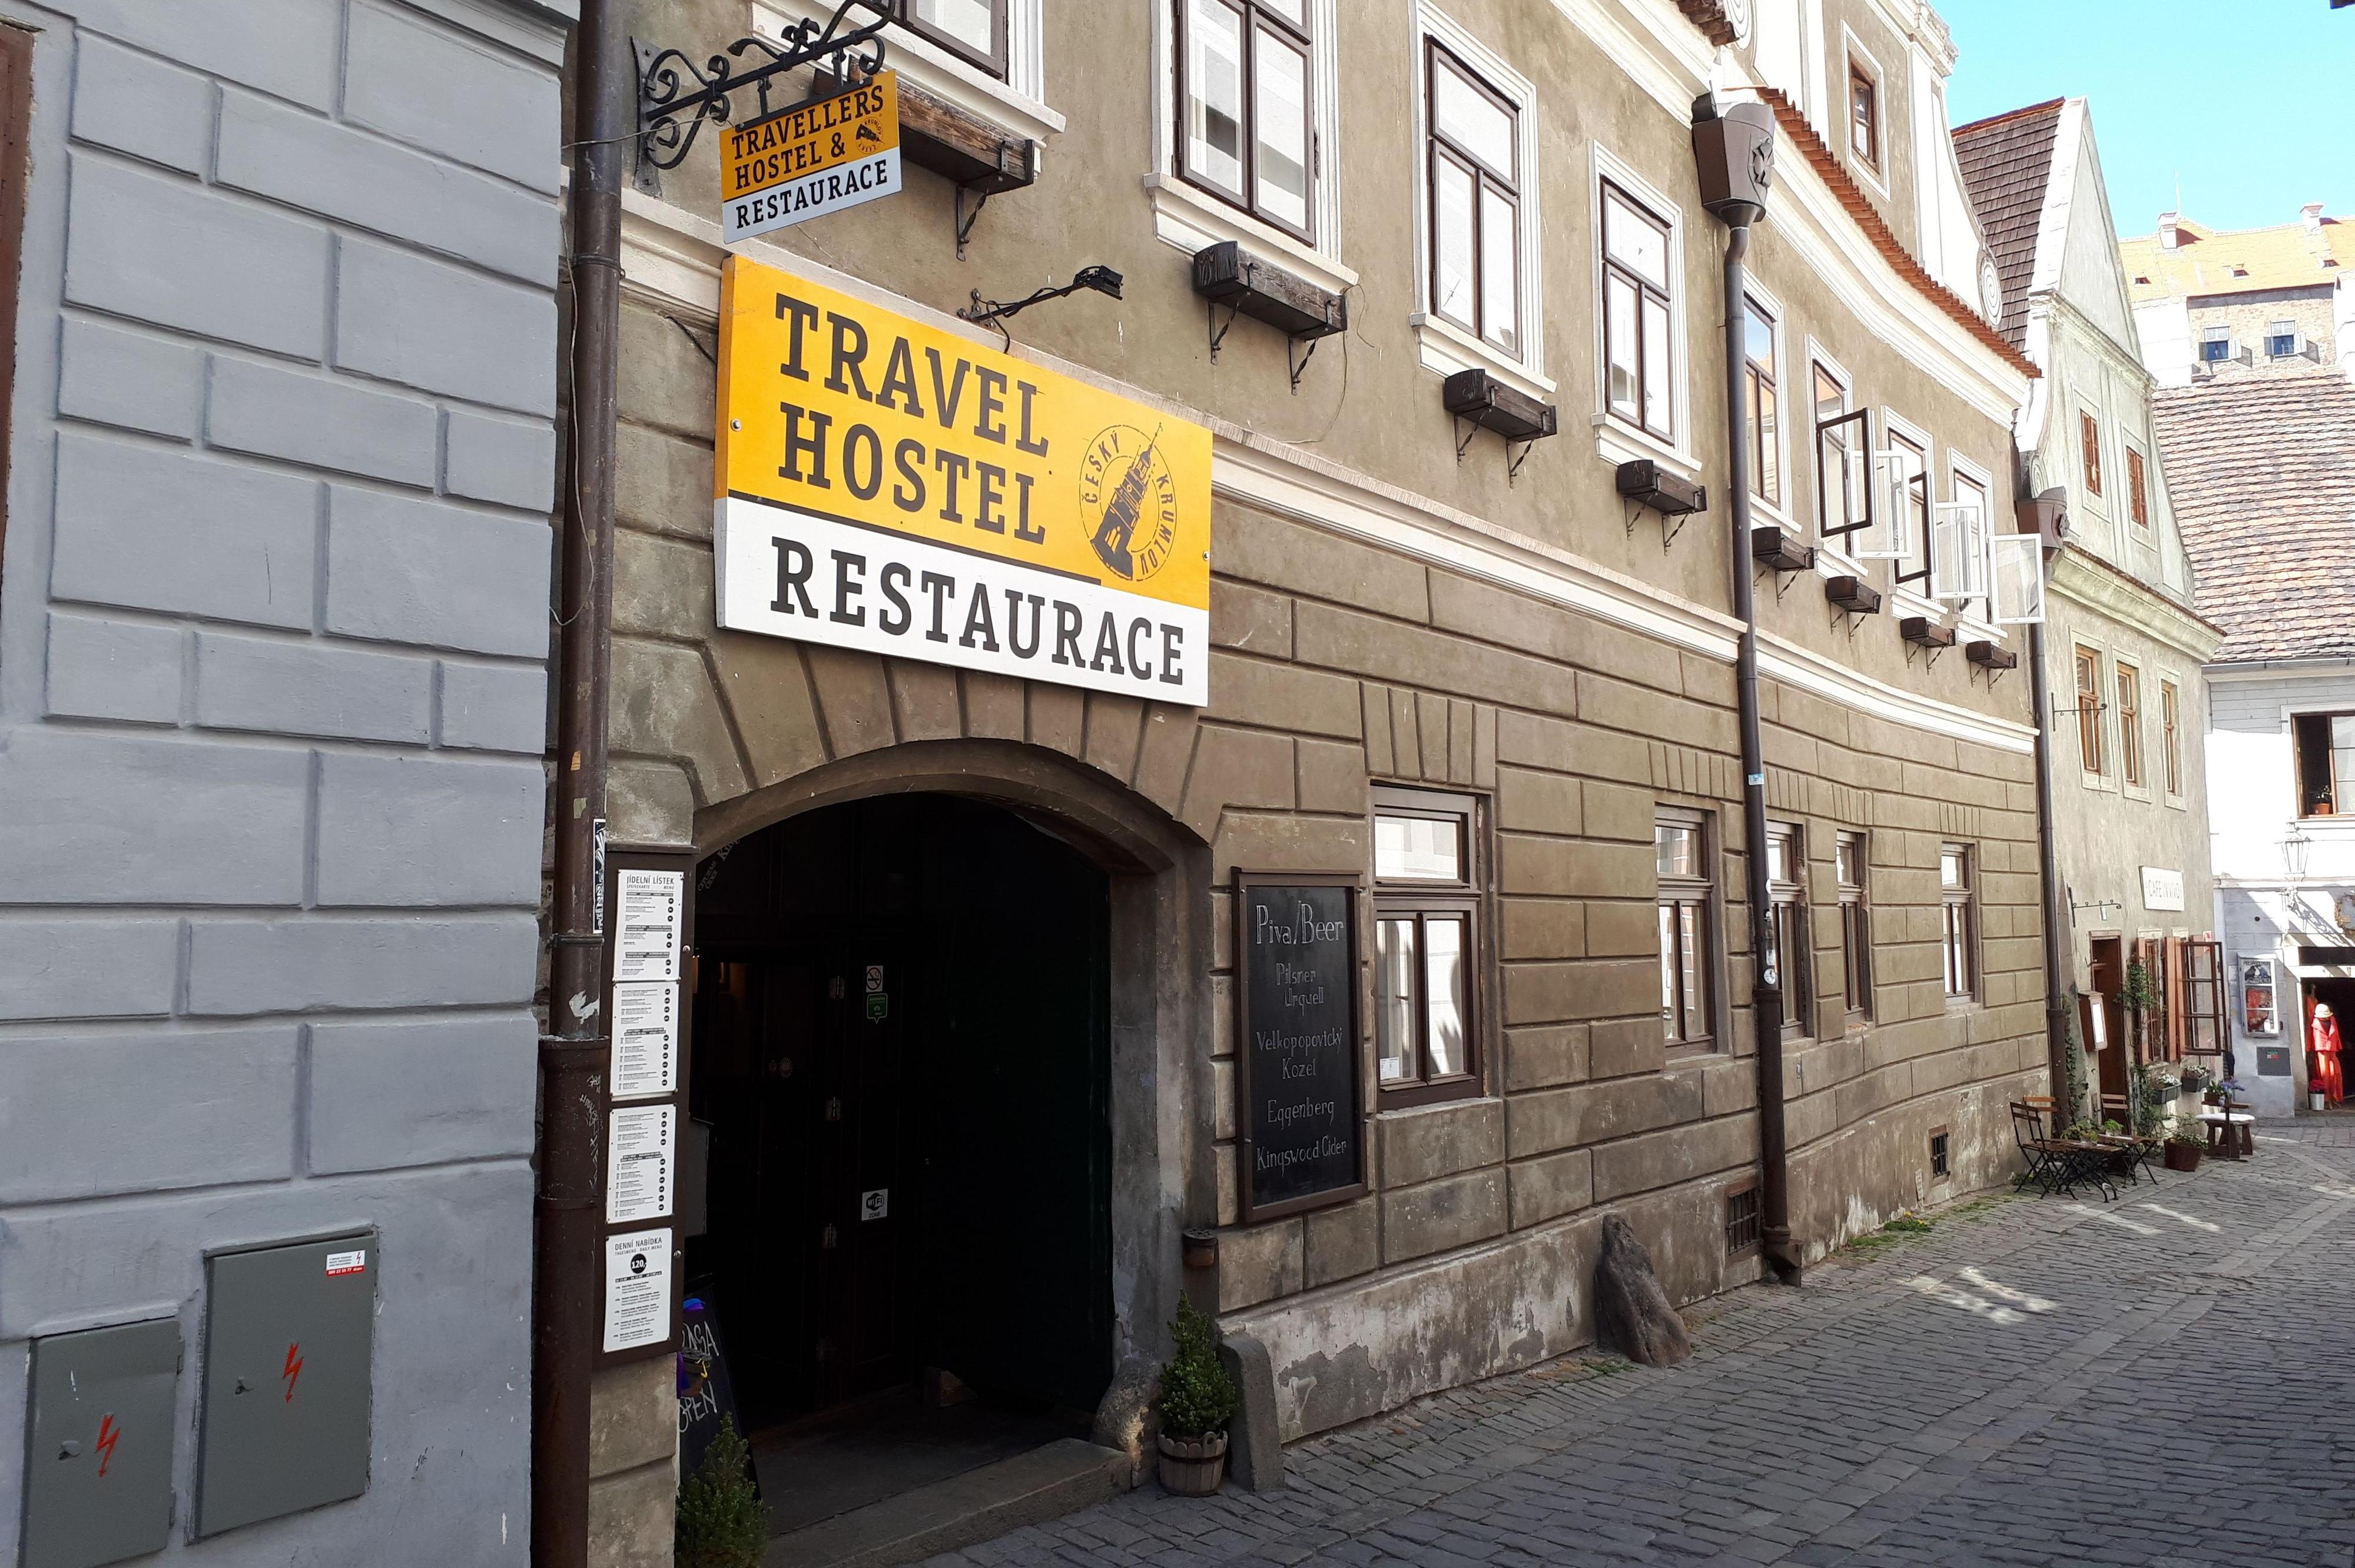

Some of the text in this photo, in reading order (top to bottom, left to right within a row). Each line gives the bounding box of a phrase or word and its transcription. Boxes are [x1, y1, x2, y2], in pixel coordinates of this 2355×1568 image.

[732, 85, 883, 160] TRAVELLERS
[735, 132, 845, 190] HOSTEL &
[736, 159, 887, 229] RESTAURACE
[775, 292, 1049, 458] TRAVEL
[778, 401, 1046, 545] HOSTEL
[1082, 430, 1119, 504] ČESKÝ
[1140, 474, 1175, 576] KRUMLOV
[770, 536, 1183, 686] RESTAURACE
[626, 875, 675, 885] JÍDELNÍ LÍSTEK
[1276, 963, 1316, 985] Pilsner
[1285, 986, 1324, 1016] Urquell
[1282, 1057, 1316, 1079] Kozel
[1268, 1097, 1334, 1130] Eggenberg
[1257, 1135, 1346, 1177] Kingswood Cider
[615, 1237, 662, 1251] DENNÍ NABÍDKA
[682, 1320, 719, 1357] ASA
